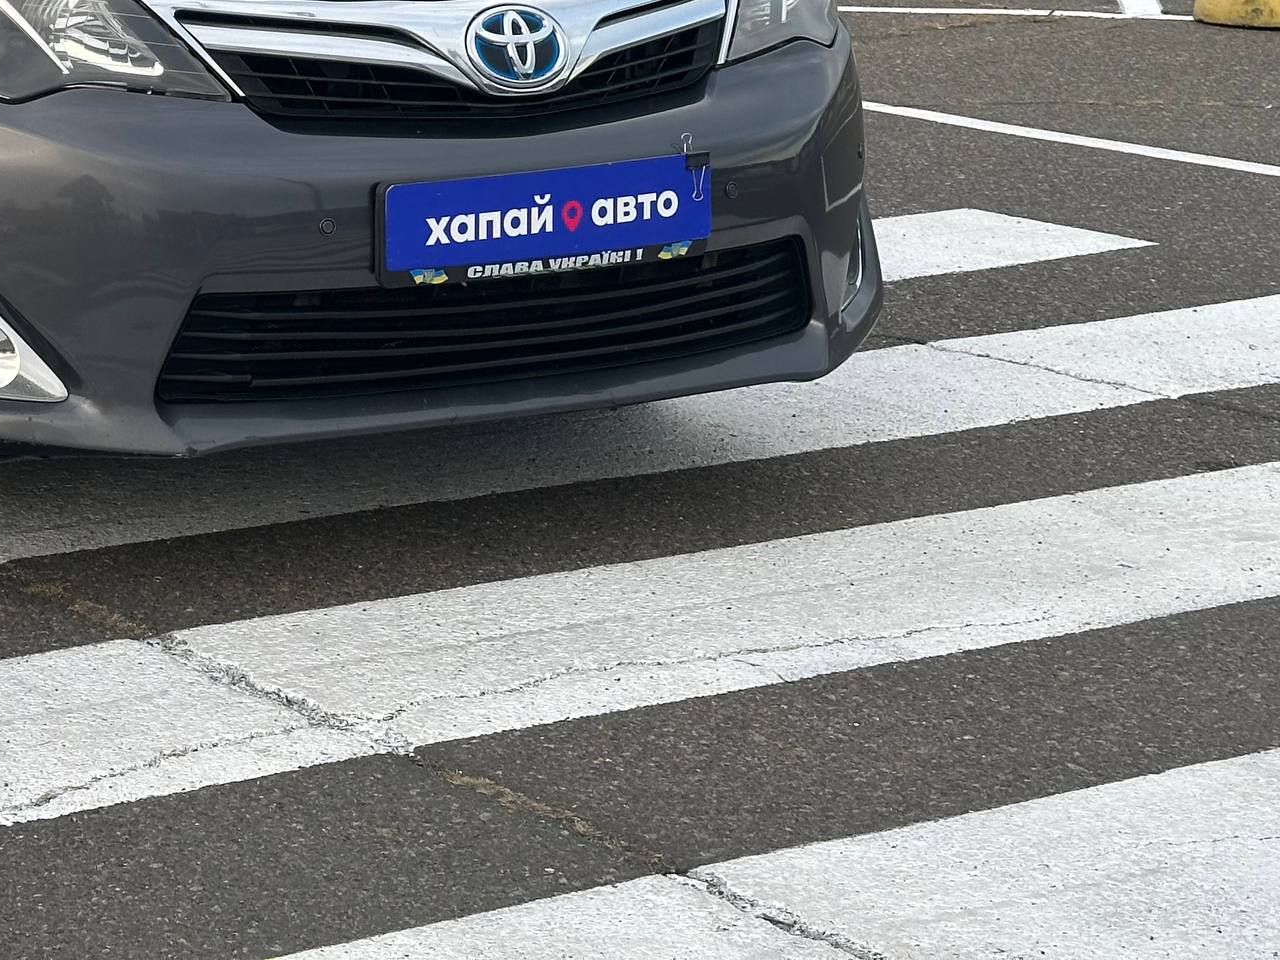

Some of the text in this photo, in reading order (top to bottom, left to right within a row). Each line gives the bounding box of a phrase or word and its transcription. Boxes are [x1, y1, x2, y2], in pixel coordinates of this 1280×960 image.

[424, 189, 680, 246] хапай авто
[467, 259, 545, 279] СЛАВА
[548, 249, 632, 272] УКРАЇНІ
